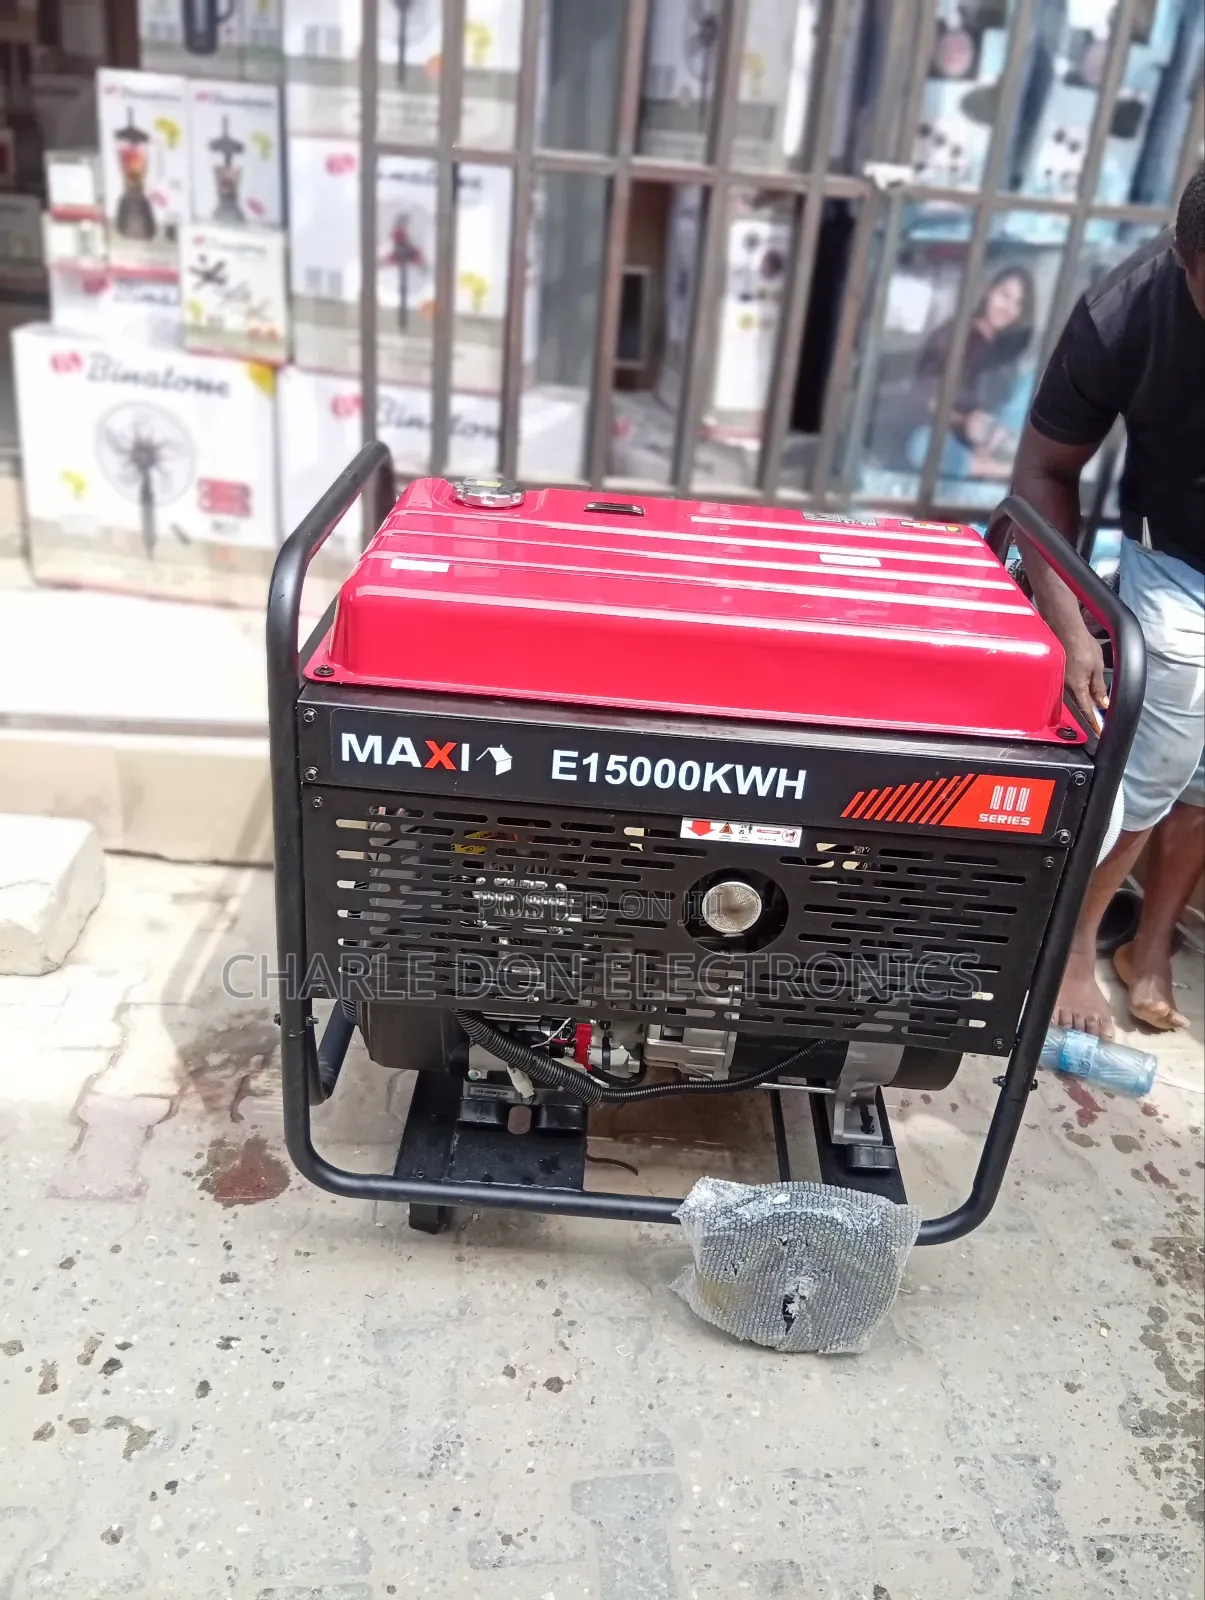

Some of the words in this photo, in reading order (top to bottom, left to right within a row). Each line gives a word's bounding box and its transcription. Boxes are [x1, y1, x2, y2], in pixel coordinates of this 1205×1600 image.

[341, 732, 470, 772] MAXI
[551, 749, 807, 800] E15000KWH
[978, 813, 1031, 826] SERIES
